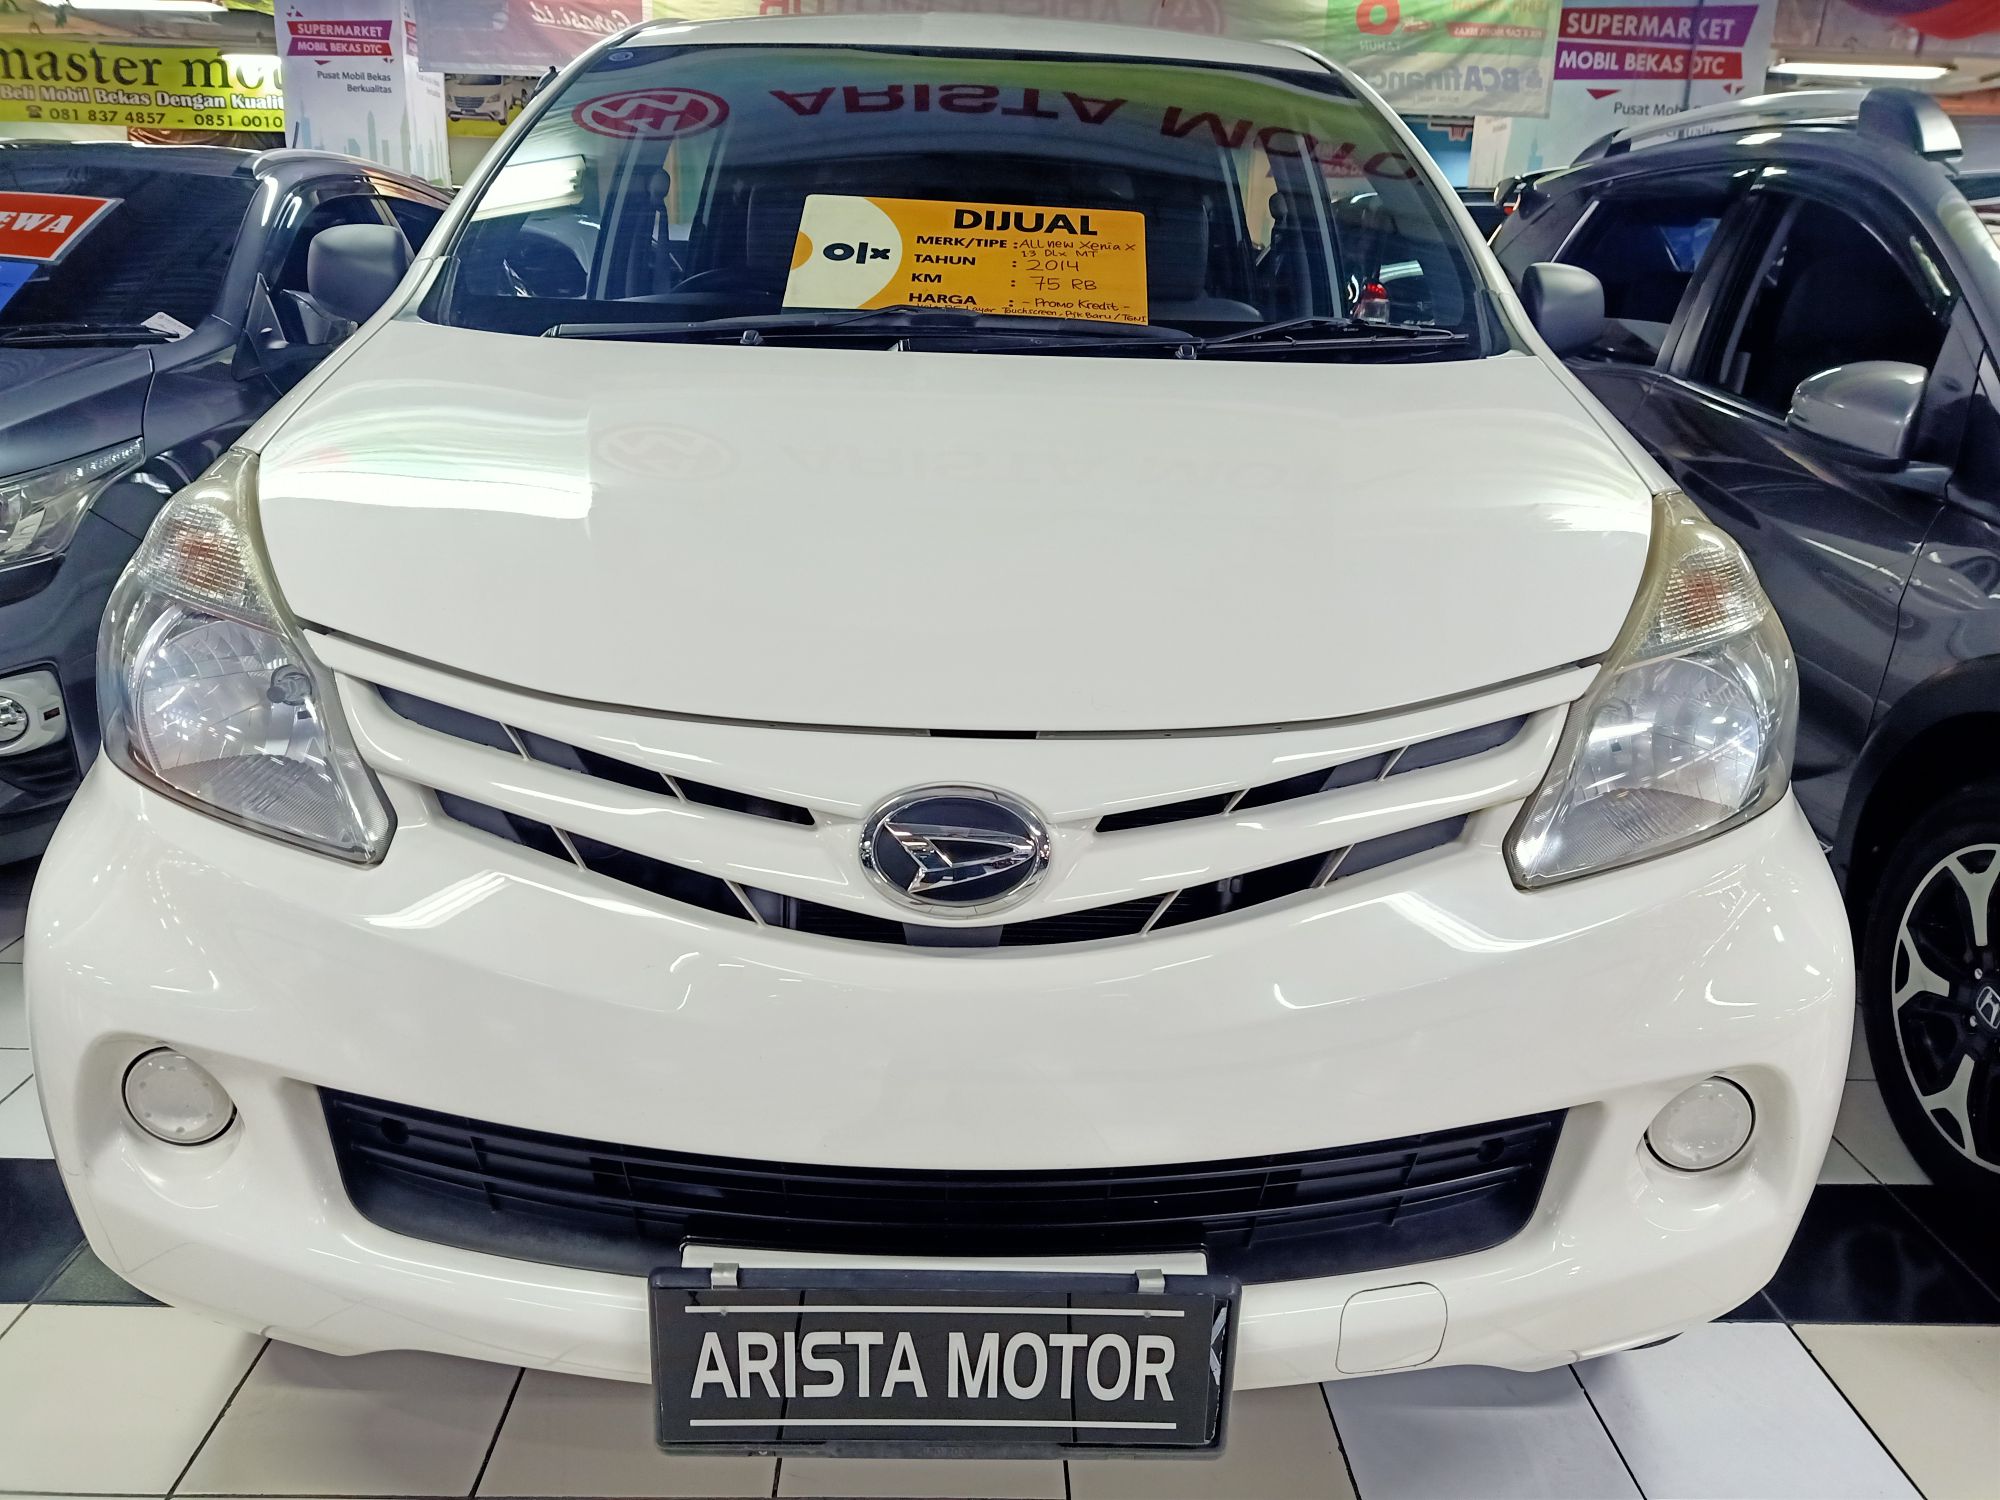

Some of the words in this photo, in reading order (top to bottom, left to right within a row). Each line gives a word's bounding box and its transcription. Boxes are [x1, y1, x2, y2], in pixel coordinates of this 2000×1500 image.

[297, 23, 383, 37] SUPERMARKET
[298, 41, 329, 52] MOBIL
[330, 42, 361, 53] BEKAS
[363, 43, 383, 54] DTC
[1559, 49, 1619, 71] MOBIL
[1624, 52, 1684, 74] BEKAS
[1691, 55, 1726, 75] DTC
[317, 71, 340, 80] Pusat
[342, 72, 365, 81] Mobil
[367, 73, 391, 82] Bekas
[1, 84, 35, 101] Beli
[39, 85, 91, 103] Mobil
[94, 88, 152, 106] Bekas
[156, 91, 227, 111] Dengan
[347, 84, 392, 94] Berkualitas
[1614, 101, 1650, 116] Pusat
[49, 108, 79, 121] 081
[88, 110, 118, 122] 837
[125, 111, 166, 124] 4857
[194, 114, 233, 127] 0851
[241, 115, 283, 128] 0010
[953, 208, 1098, 236] DIJUAL
[916, 235, 1007, 249] MERK/TIPE
[822, 242, 891, 265] olx
[1075, 250, 1099, 258] MT
[914, 254, 976, 266] TAHUN
[1026, 259, 1080, 272] 2014
[911, 272, 942, 284] KM
[1029, 276, 1061, 291] 75
[1071, 278, 1098, 291] RB
[908, 292, 977, 306] HARGA
[1078, 298, 1119, 311] Kredit
[689, 1330, 929, 1400] ARISTA
[946, 1331, 1176, 1402] MOTOR
